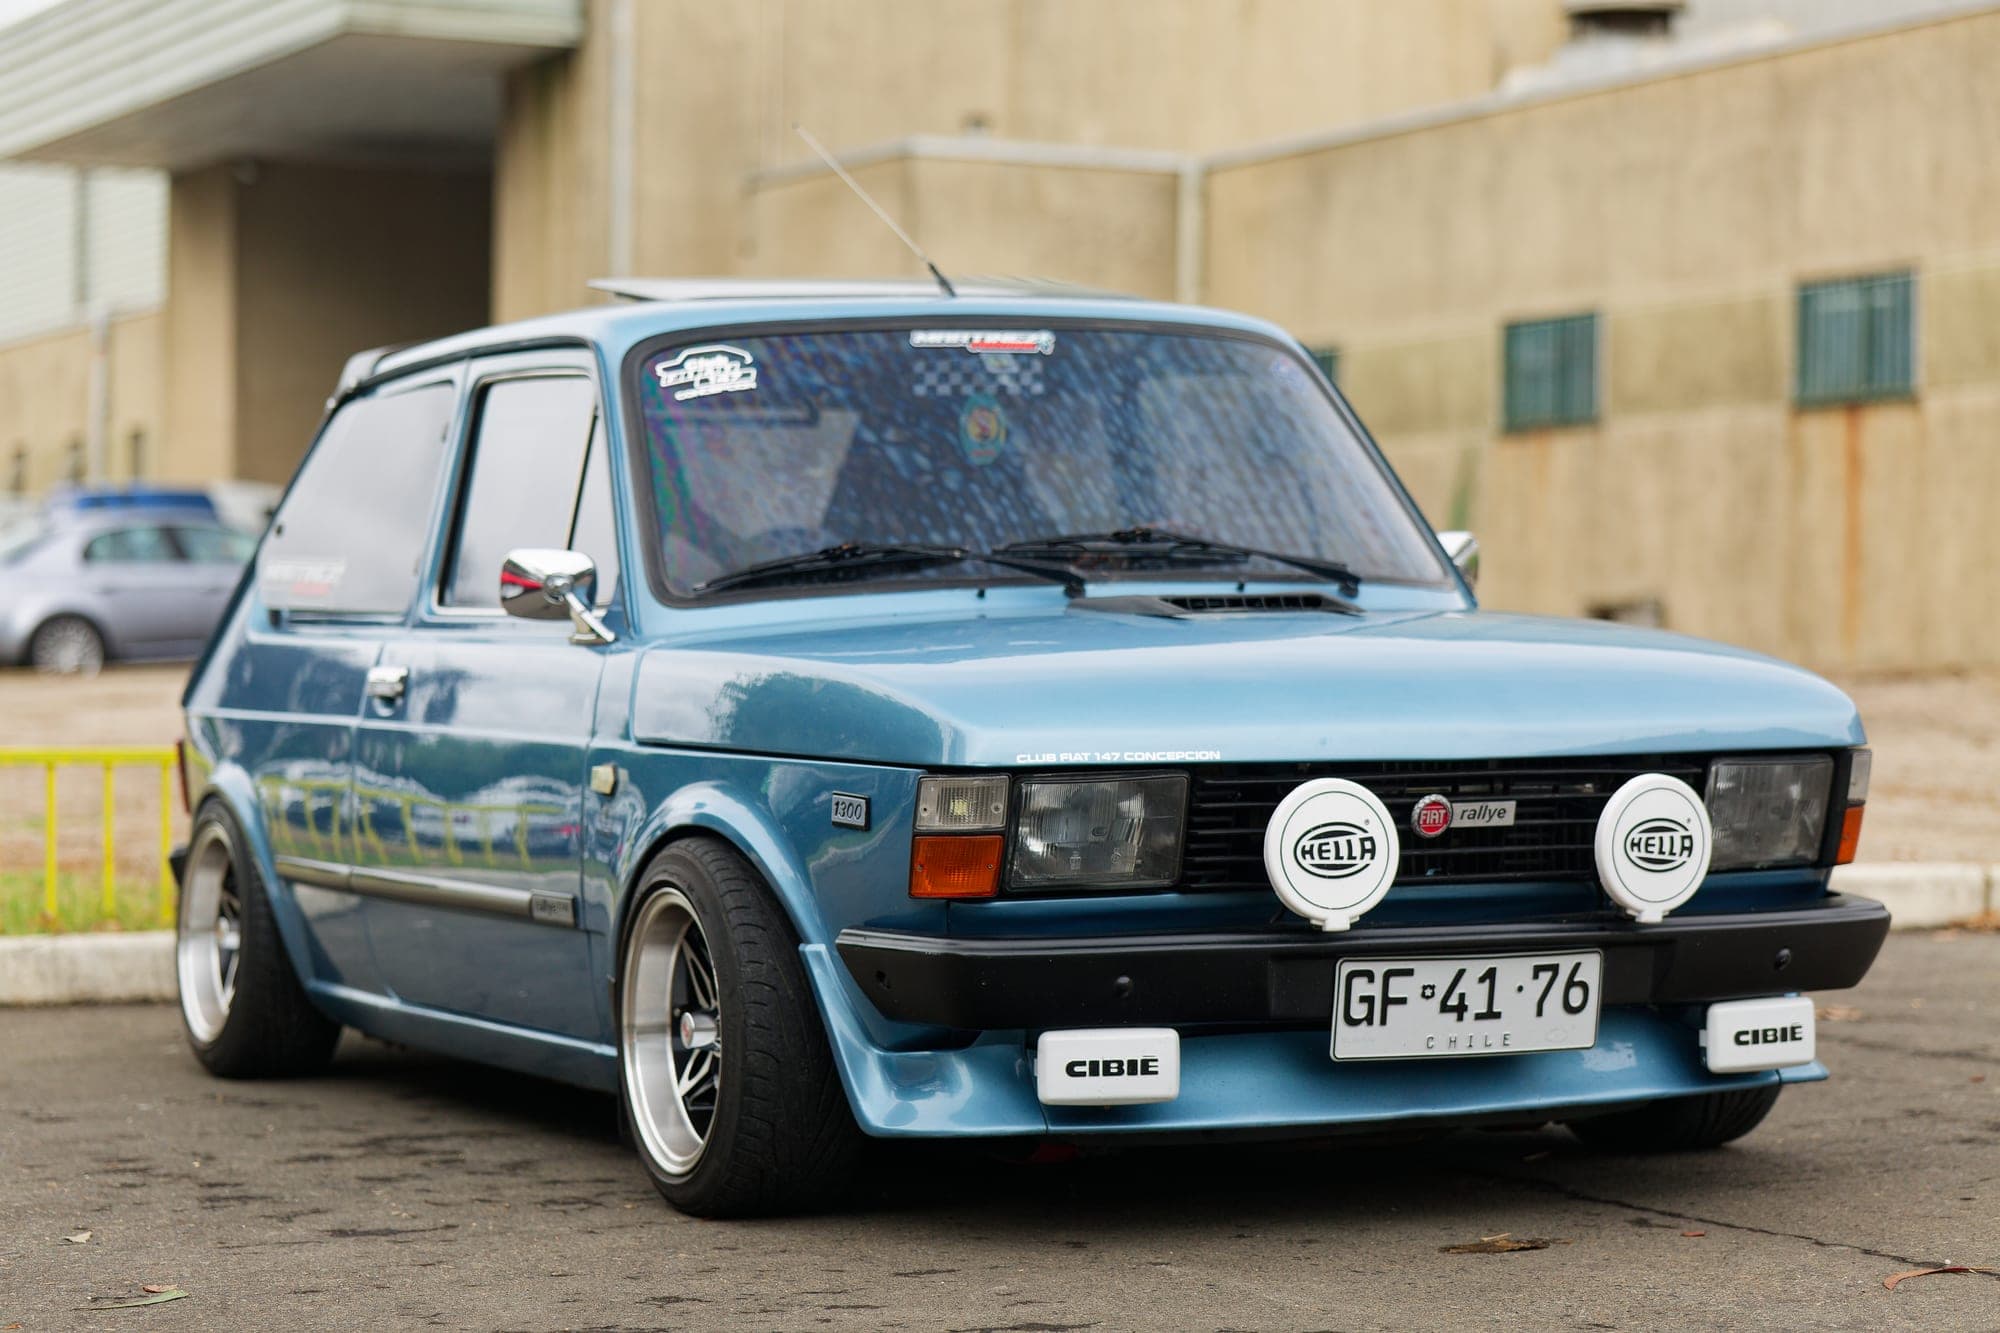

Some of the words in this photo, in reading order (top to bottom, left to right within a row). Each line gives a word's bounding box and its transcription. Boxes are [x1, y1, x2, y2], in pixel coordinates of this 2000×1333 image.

[1016, 752, 1057, 764] CLUB
[1060, 751, 1089, 762] FIAT
[1094, 751, 1121, 761] 147
[1124, 750, 1221, 761] CONCEPCION
[834, 800, 863, 820] 1300
[1419, 808, 1447, 825] FIAT
[1459, 804, 1507, 824] rallye
[1300, 835, 1377, 861] HELLA
[1629, 834, 1694, 859] HELLA
[1342, 967, 1415, 1027] GF
[1425, 1032, 1512, 1050] CHILE
